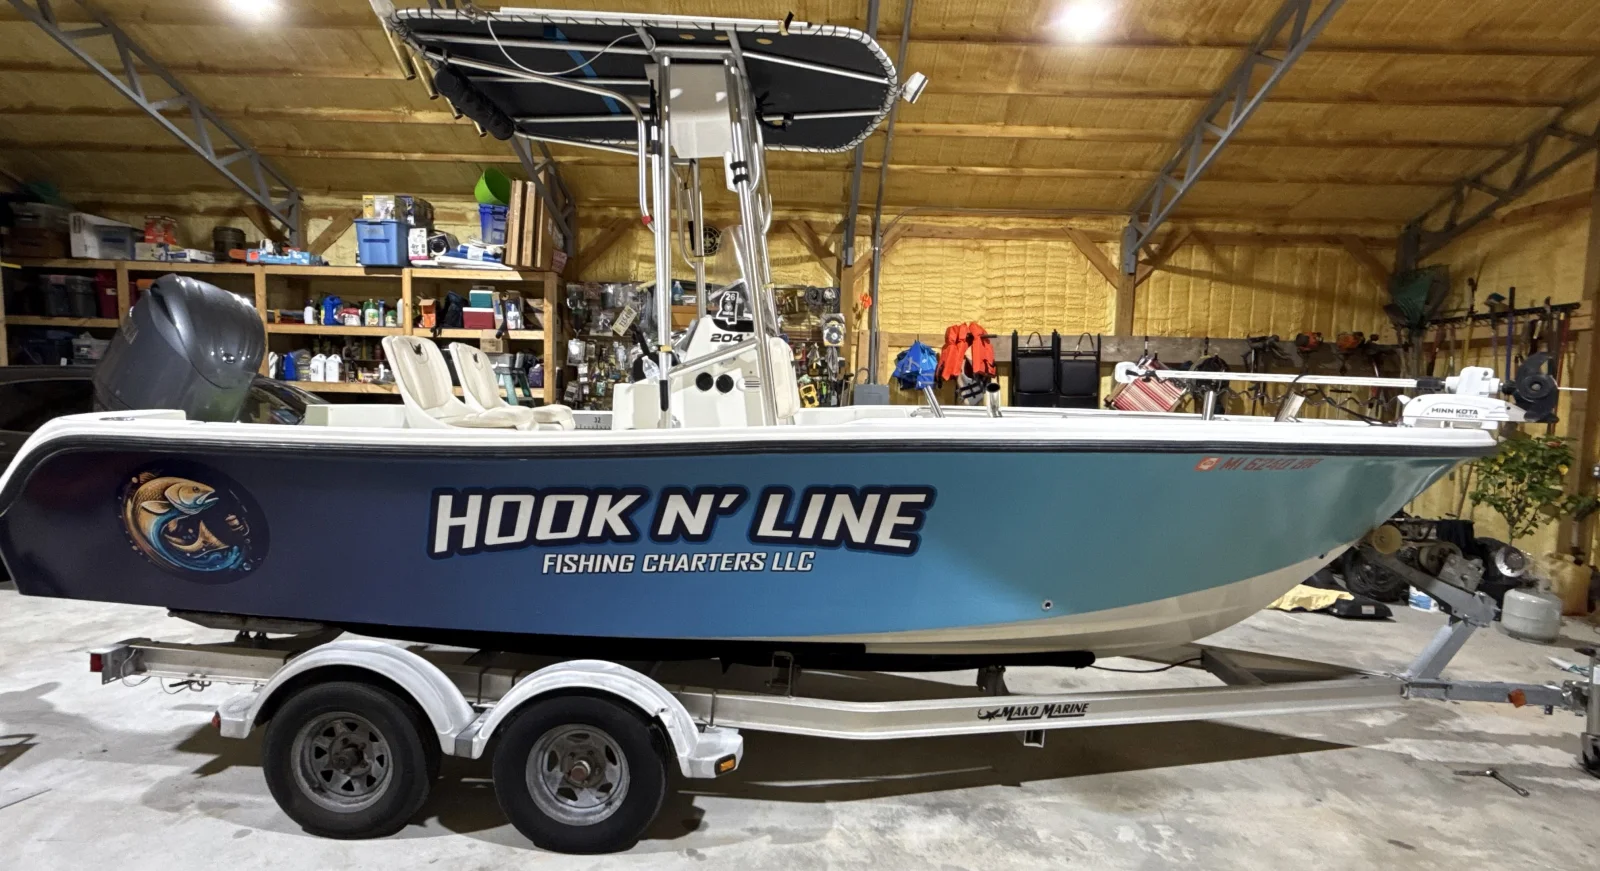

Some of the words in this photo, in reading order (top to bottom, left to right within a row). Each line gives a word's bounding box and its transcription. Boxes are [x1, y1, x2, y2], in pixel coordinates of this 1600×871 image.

[710, 333, 743, 343] 204
[434, 494, 642, 553] HOOK
[757, 493, 926, 548] LINE
[542, 553, 636, 574] FISHING
[642, 552, 767, 572] CHARTERS
[771, 551, 816, 571] LLC
[1001, 705, 1042, 720] MAKO
[1041, 703, 1090, 718] MARINE
